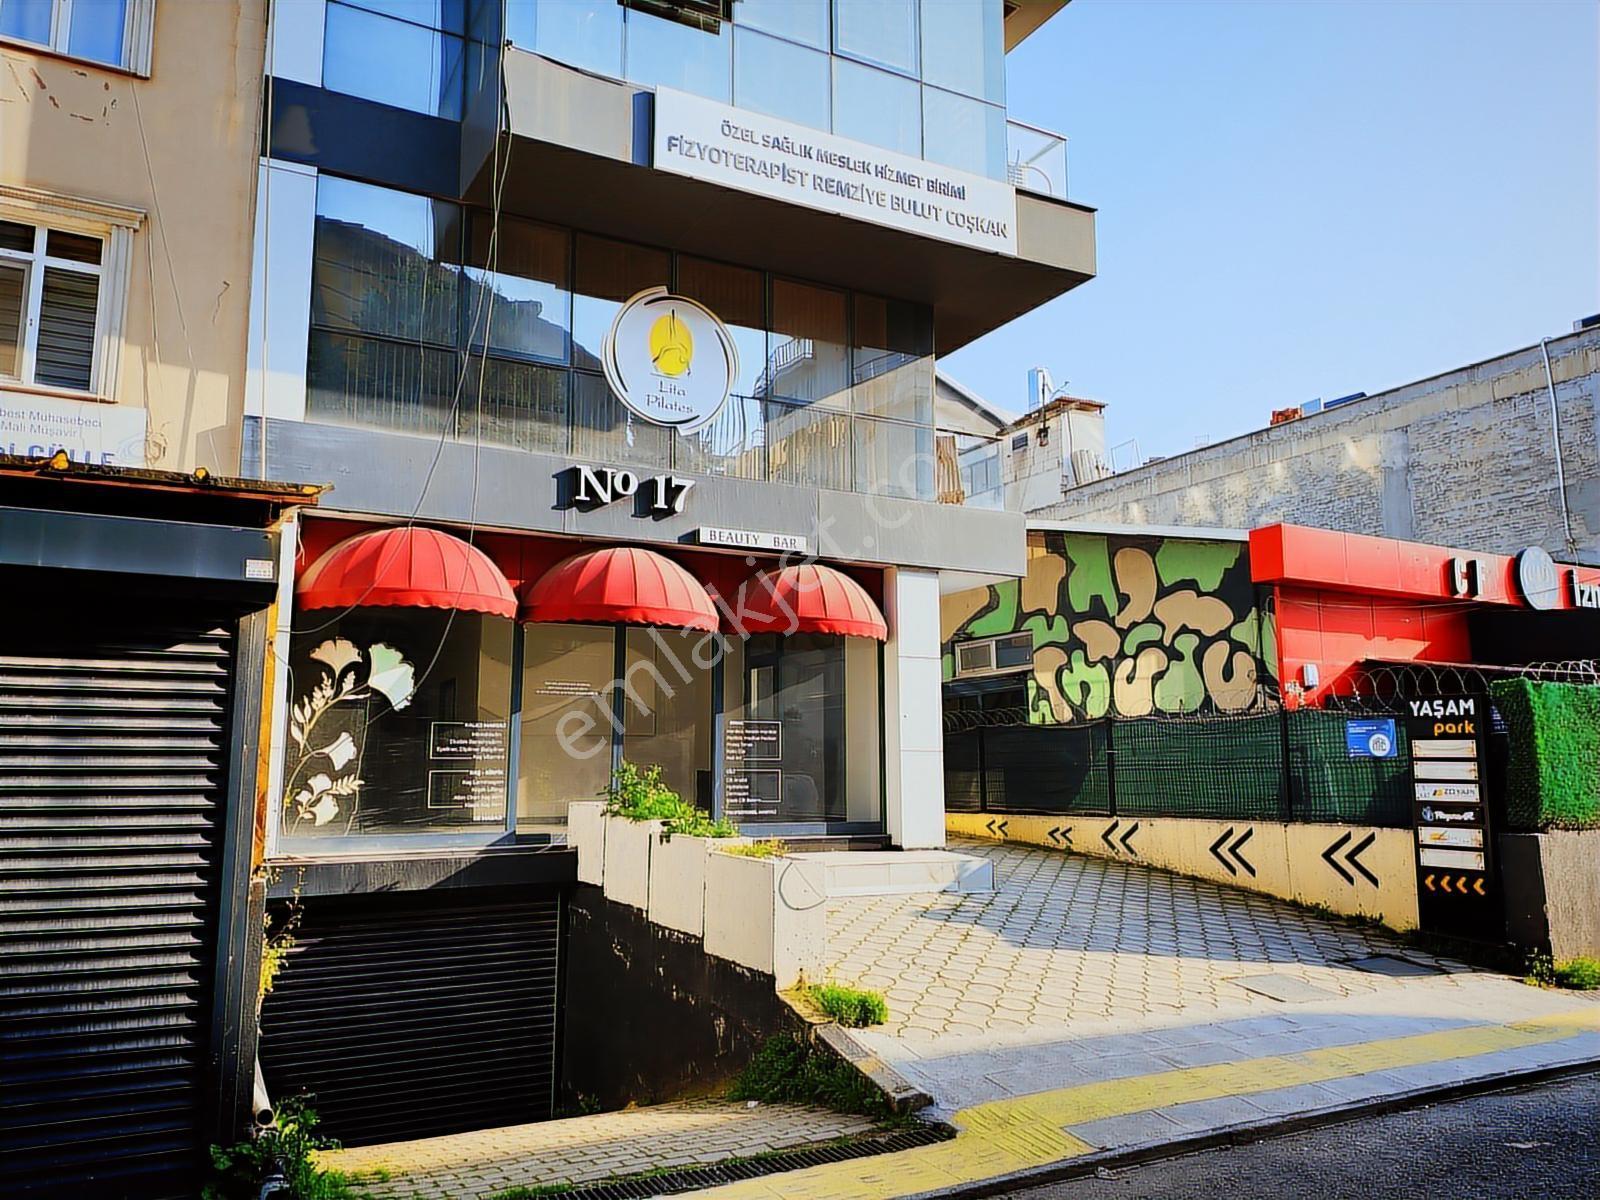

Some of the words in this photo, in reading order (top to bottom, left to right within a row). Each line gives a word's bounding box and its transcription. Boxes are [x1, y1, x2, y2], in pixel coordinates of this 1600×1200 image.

[721, 120, 759, 145] ÖZEL
[762, 135, 813, 160] SAĞLIK
[816, 149, 871, 175] MESLEK
[875, 163, 924, 189] HİZMET
[926, 177, 966, 201] BİRİMİ
[667, 135, 809, 187] FİZYOTERAPİST
[813, 174, 886, 208] REMZİYE
[891, 194, 942, 222] BULUT
[946, 210, 1008, 239] COŞKAN
[645, 394, 693, 413] Pilates
[575, 464, 639, 504] No
[654, 474, 696, 513] 17
[709, 530, 760, 545] BEAUTY
[773, 536, 797, 549] BAR
[1409, 698, 1475, 719] YAŞAM
[1434, 720, 1475, 736] park
